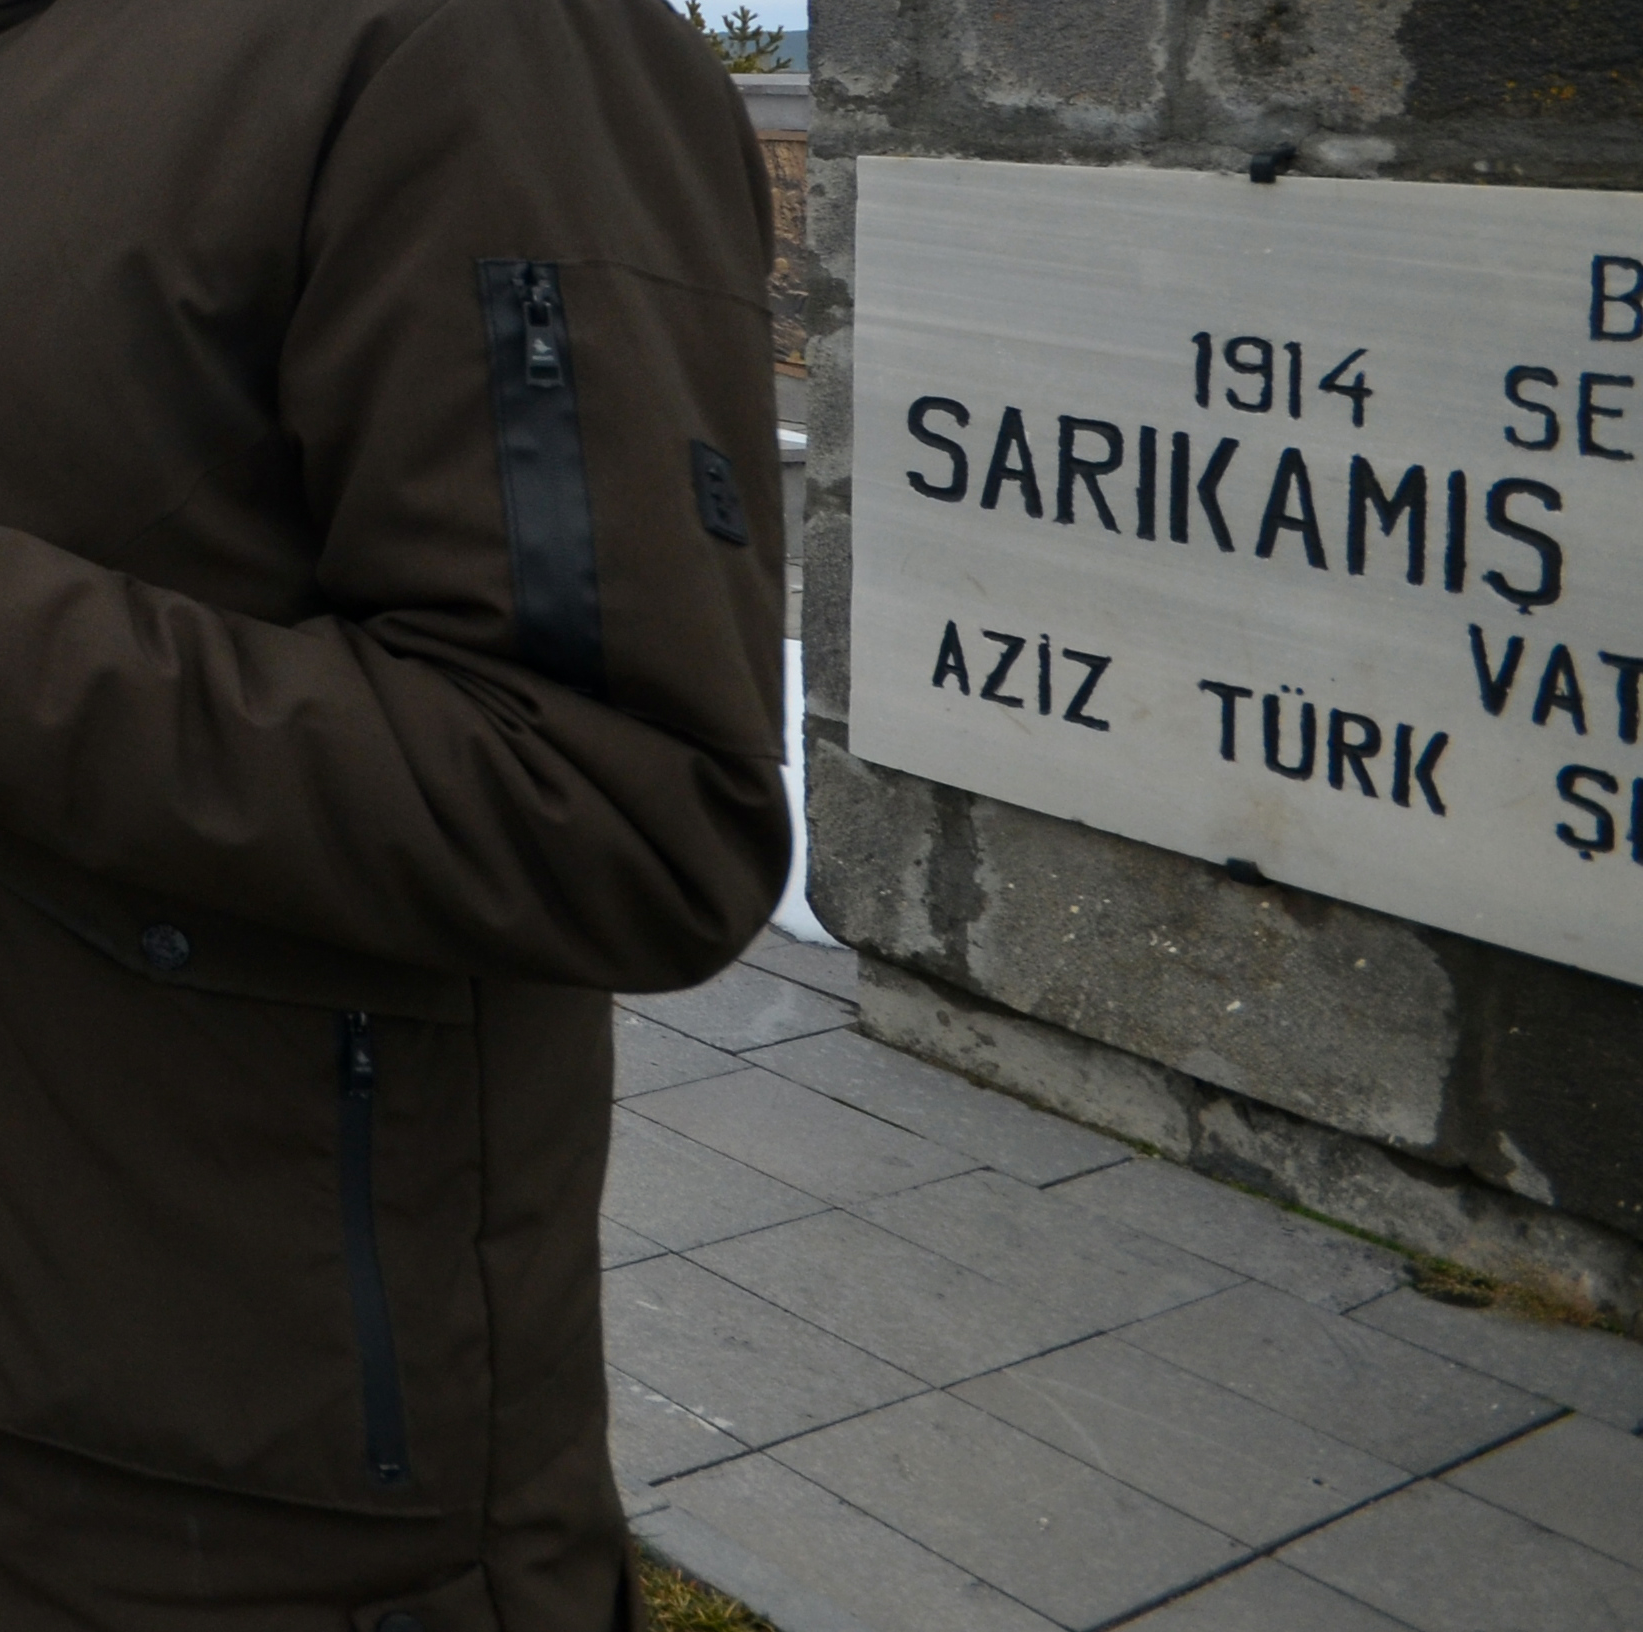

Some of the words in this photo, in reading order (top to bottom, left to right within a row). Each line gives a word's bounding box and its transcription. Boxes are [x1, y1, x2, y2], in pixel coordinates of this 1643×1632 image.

[1191, 331, 1373, 429] 1914
[1504, 365, 1635, 462] SE
[906, 395, 1564, 616] SARIKAMIŞ
[932, 620, 1113, 732] AZİZ
[1198, 679, 1450, 818] TÜRK
[1555, 764, 1643, 866] Ş
[1468, 623, 1643, 745] VAT
